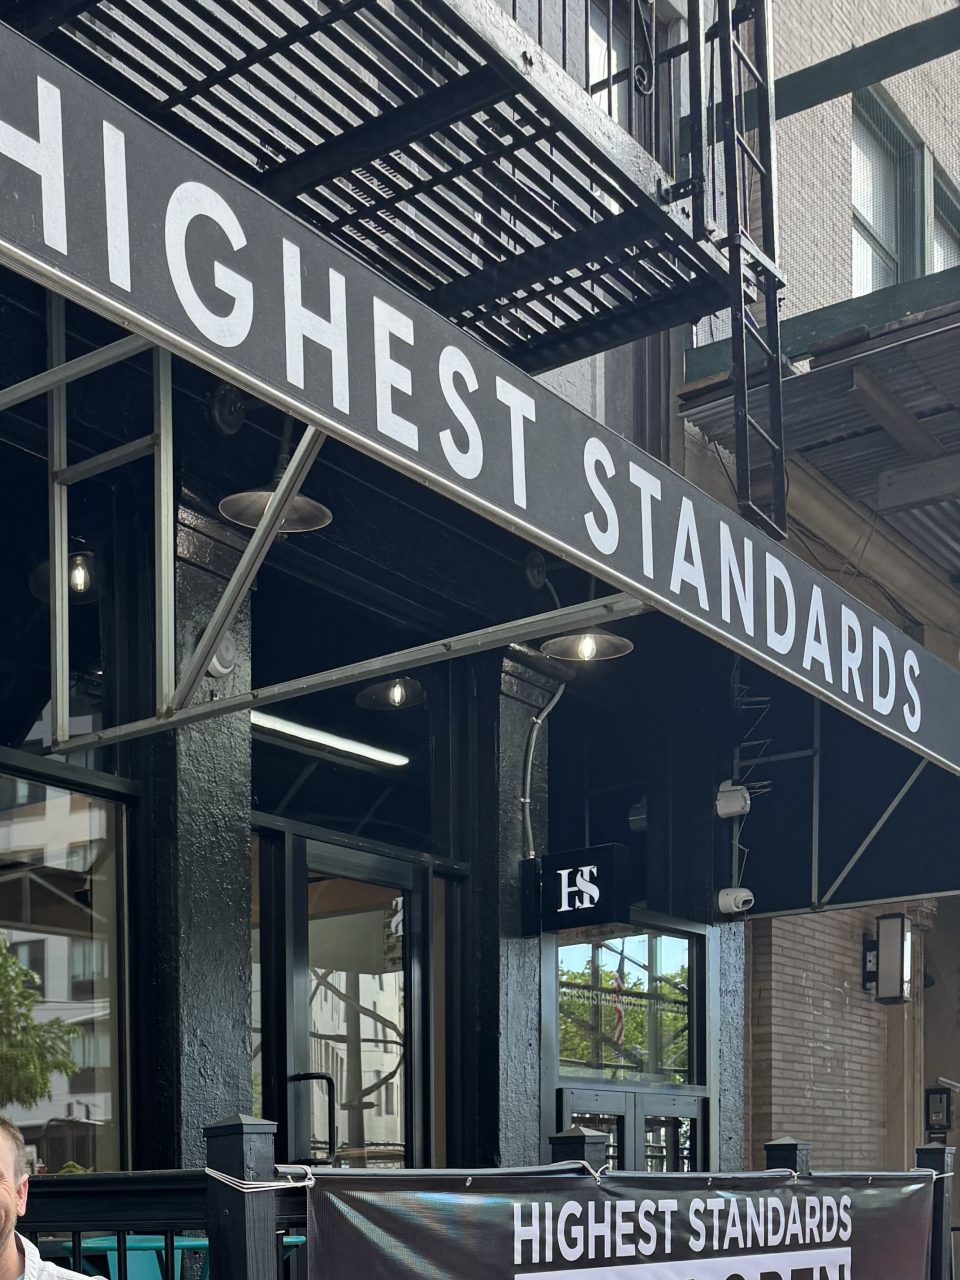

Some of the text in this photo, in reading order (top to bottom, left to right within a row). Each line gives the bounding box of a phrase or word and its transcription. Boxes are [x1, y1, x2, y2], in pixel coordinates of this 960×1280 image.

[584, 438, 922, 733] STANDARDS
[514, 1194, 852, 1264] HIGHEST STANDARDS
